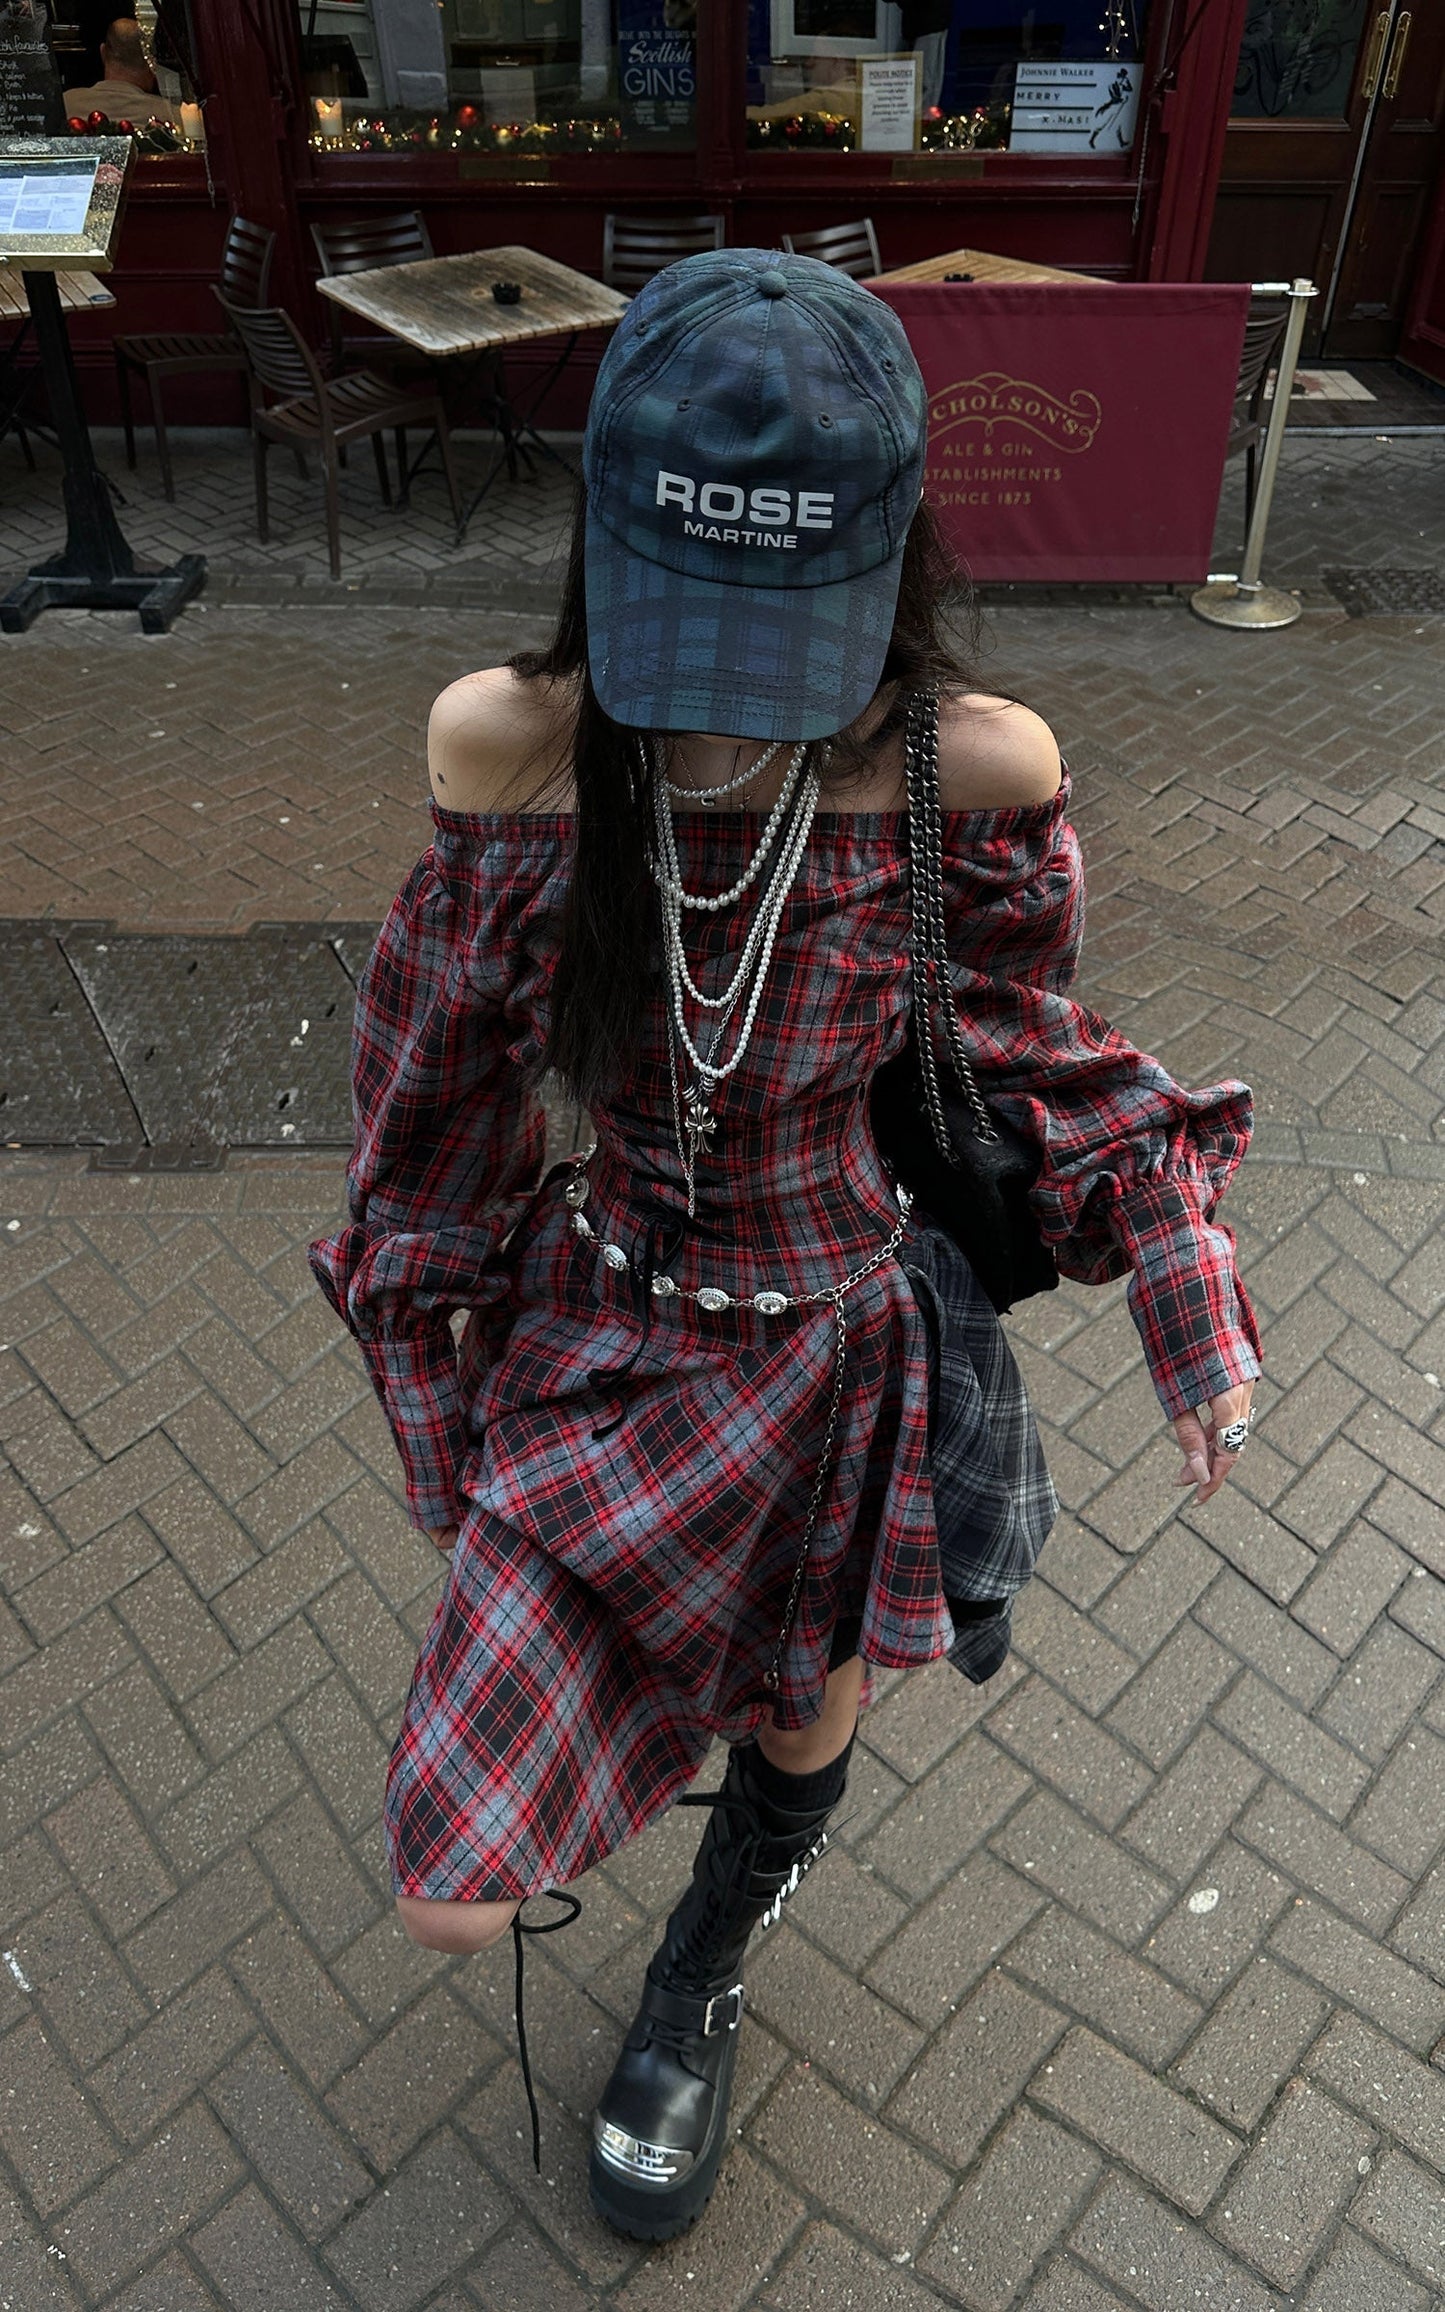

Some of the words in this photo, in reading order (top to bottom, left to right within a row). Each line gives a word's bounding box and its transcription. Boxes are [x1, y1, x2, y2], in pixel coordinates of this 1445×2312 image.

[628, 40, 692, 63] Scottish
[624, 68, 695, 96] GINS
[1060, 67, 1094, 76] WALKER
[1016, 91, 1061, 101] MERRY
[928, 394, 1079, 435] CHOLSON'S
[942, 443, 975, 456] ALE
[983, 443, 993, 456] &
[1001, 443, 1033, 456] GIN
[656, 470, 835, 529] ROSE
[938, 492, 990, 505] SINCE
[998, 492, 1032, 505] 1873
[684, 520, 798, 549] MARTINE
